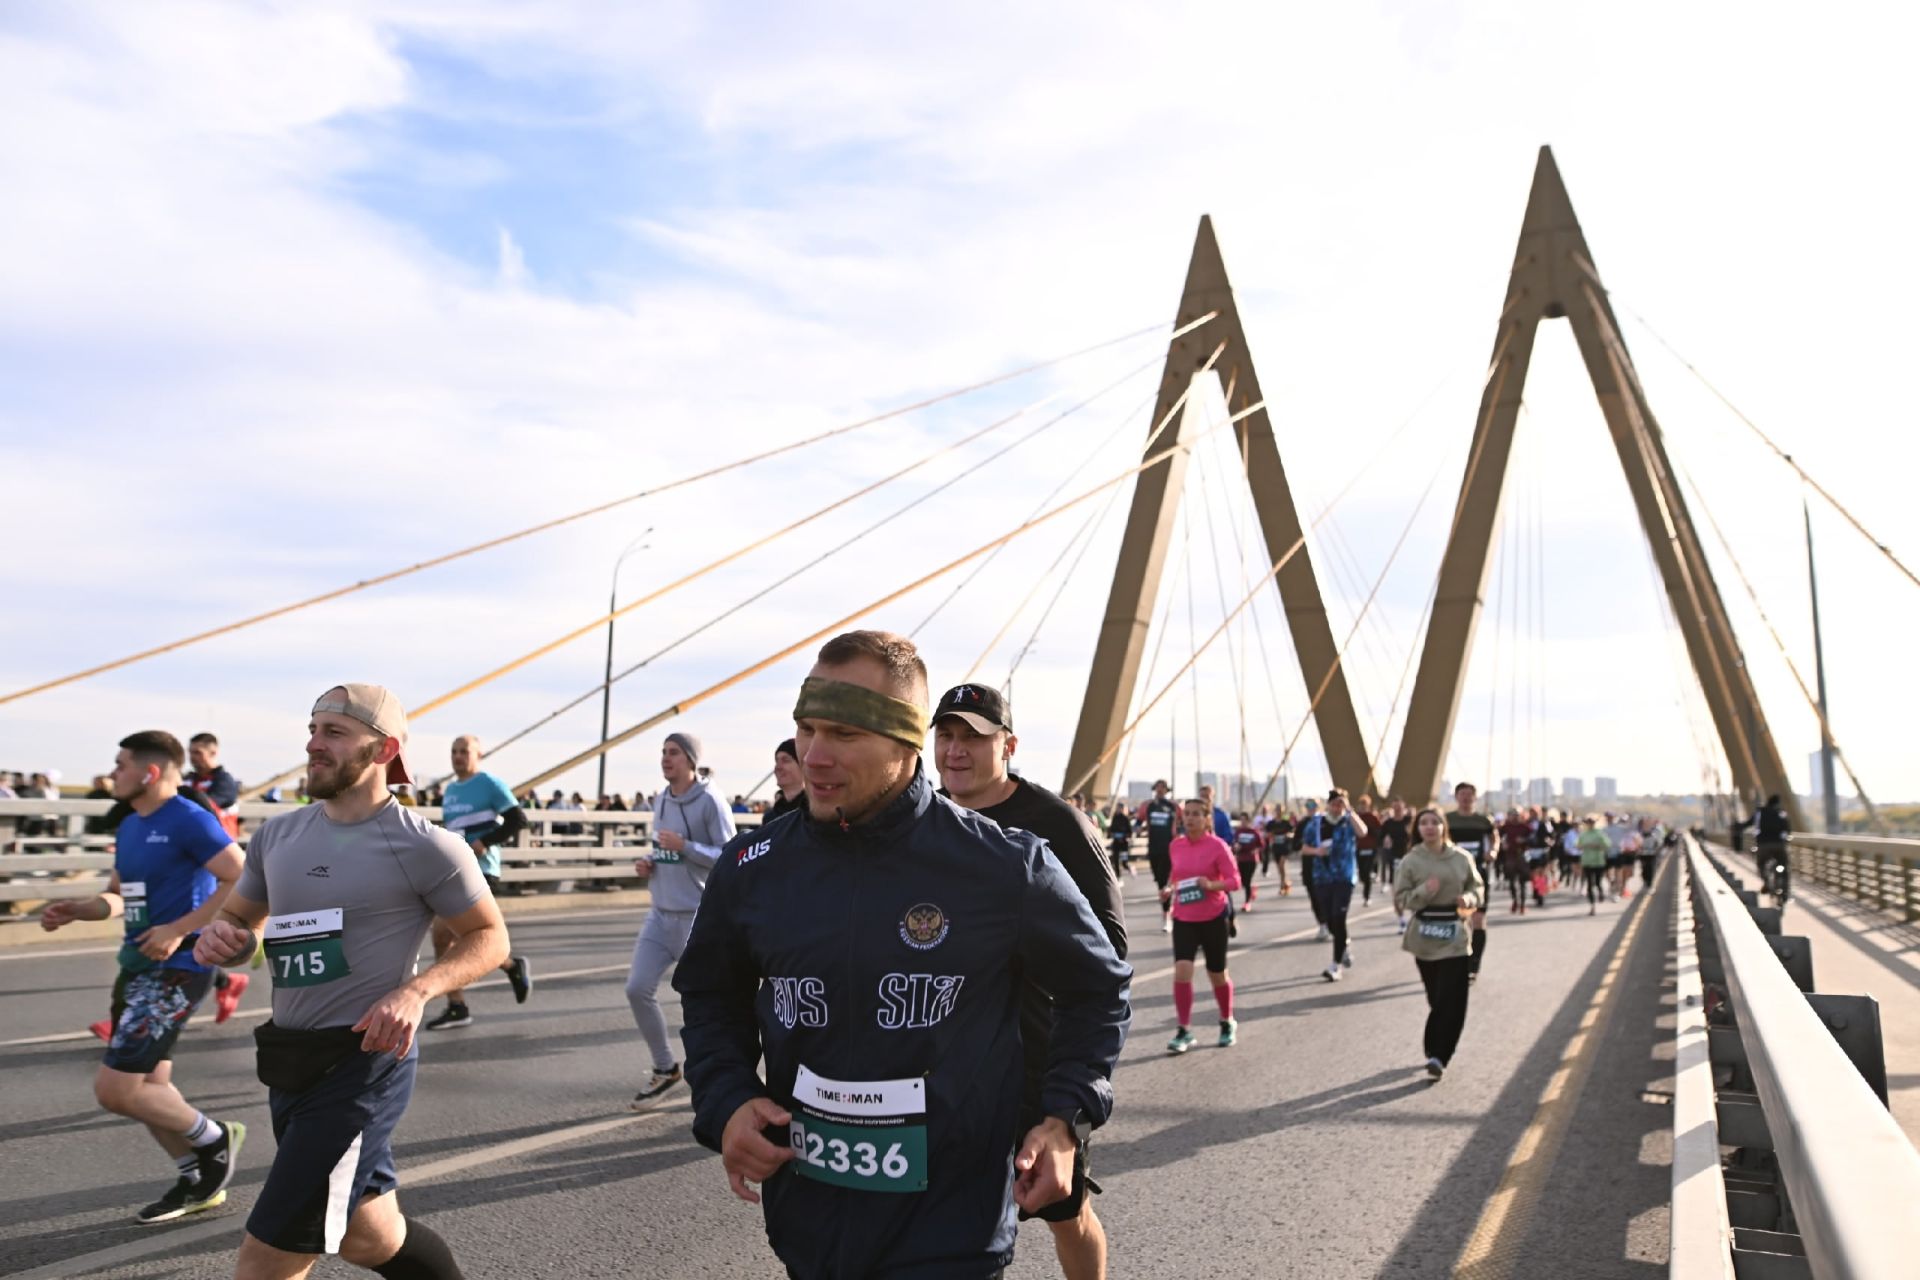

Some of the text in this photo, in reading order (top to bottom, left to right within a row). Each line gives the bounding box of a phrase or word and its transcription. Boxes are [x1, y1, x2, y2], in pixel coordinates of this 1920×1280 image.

[737, 839, 771, 866] RUS
[278, 951, 326, 978] 715
[806, 1132, 909, 1179] 2336
